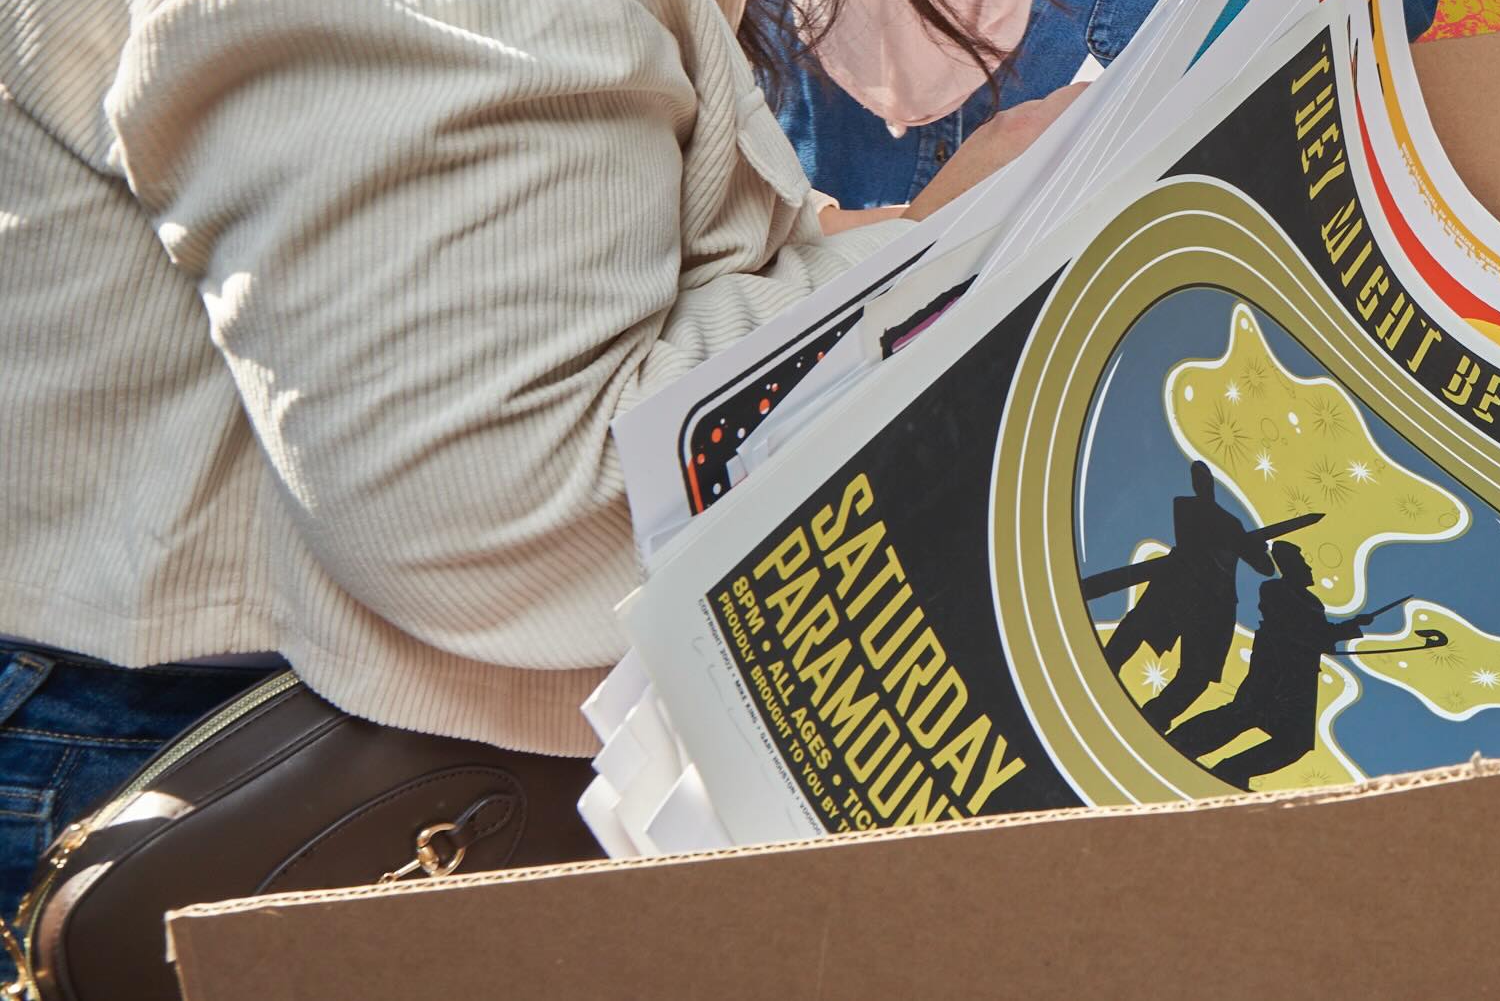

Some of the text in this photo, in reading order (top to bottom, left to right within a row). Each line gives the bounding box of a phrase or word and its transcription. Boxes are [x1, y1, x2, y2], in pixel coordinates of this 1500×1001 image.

[1291, 44, 1346, 200] THEY
[1321, 198, 1442, 373] MIGHT
[697, 598, 725, 645] COPYRIGHT
[735, 679, 749, 703] MIKE
[746, 703, 758, 725] KING
[760, 731, 775, 758] GARY
[772, 755, 797, 801] HOUSTON
[718, 591, 840, 819] PROUDLY BROUGHT TO YOU BY
[733, 576, 765, 635] 8PM
[767, 660, 795, 706] ALL
[791, 707, 832, 770] AGES
[811, 473, 1026, 815] SATURDAY
